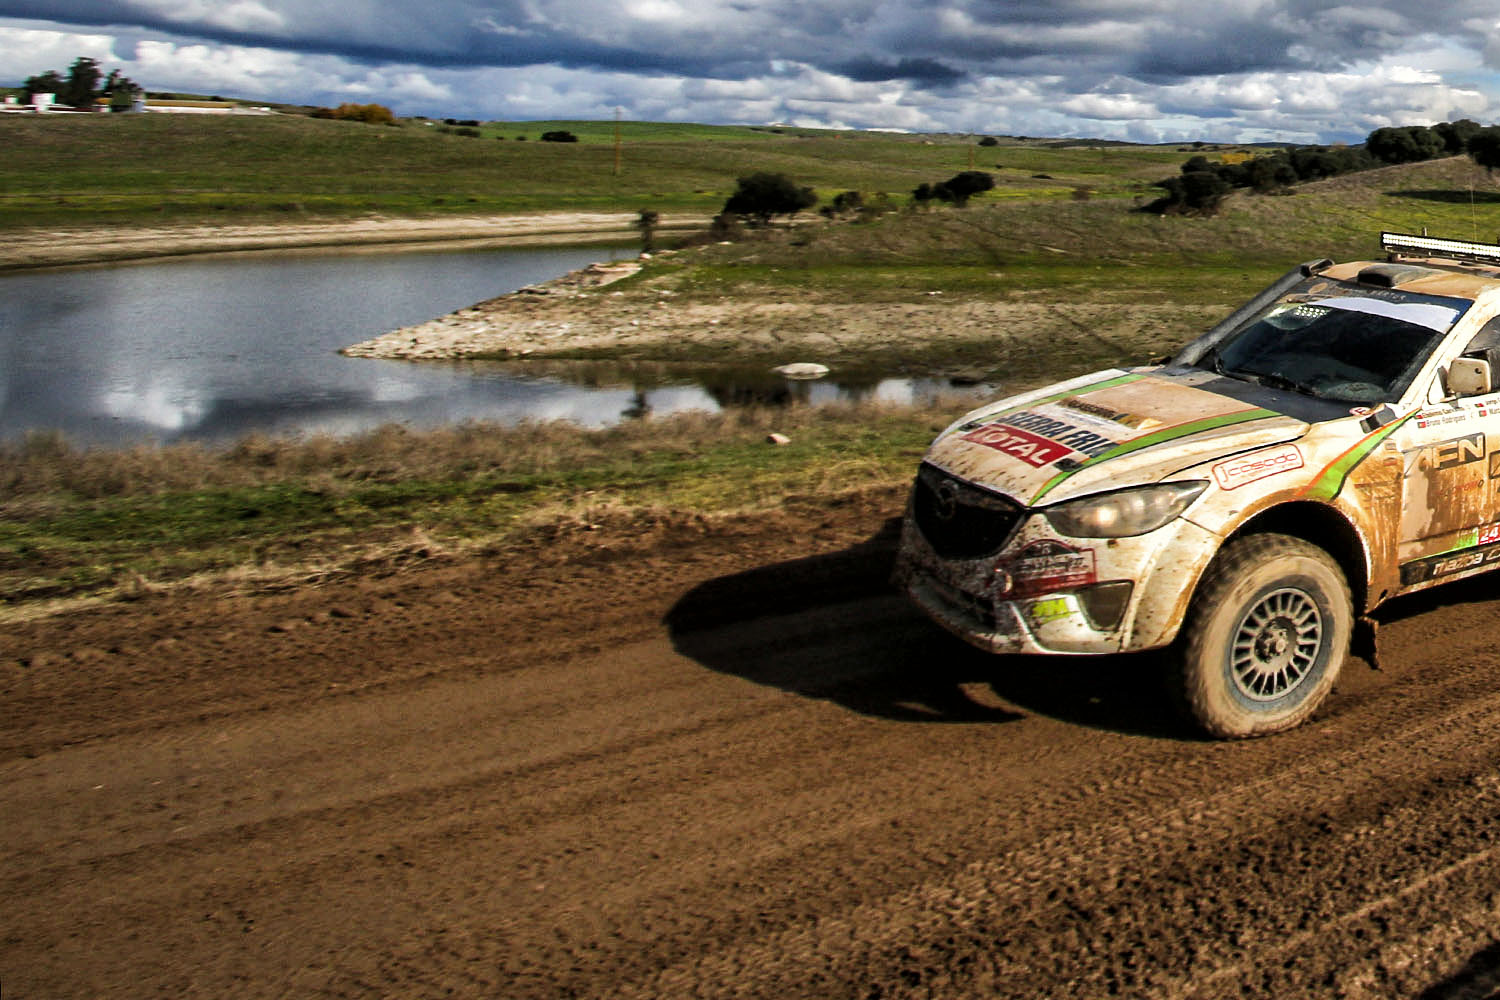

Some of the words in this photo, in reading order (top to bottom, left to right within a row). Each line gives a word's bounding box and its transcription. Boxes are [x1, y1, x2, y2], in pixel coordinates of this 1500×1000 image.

[999, 411, 1076, 441] SIERRA
[976, 427, 1051, 464] TOTAL
[1479, 526, 1499, 542] 24
